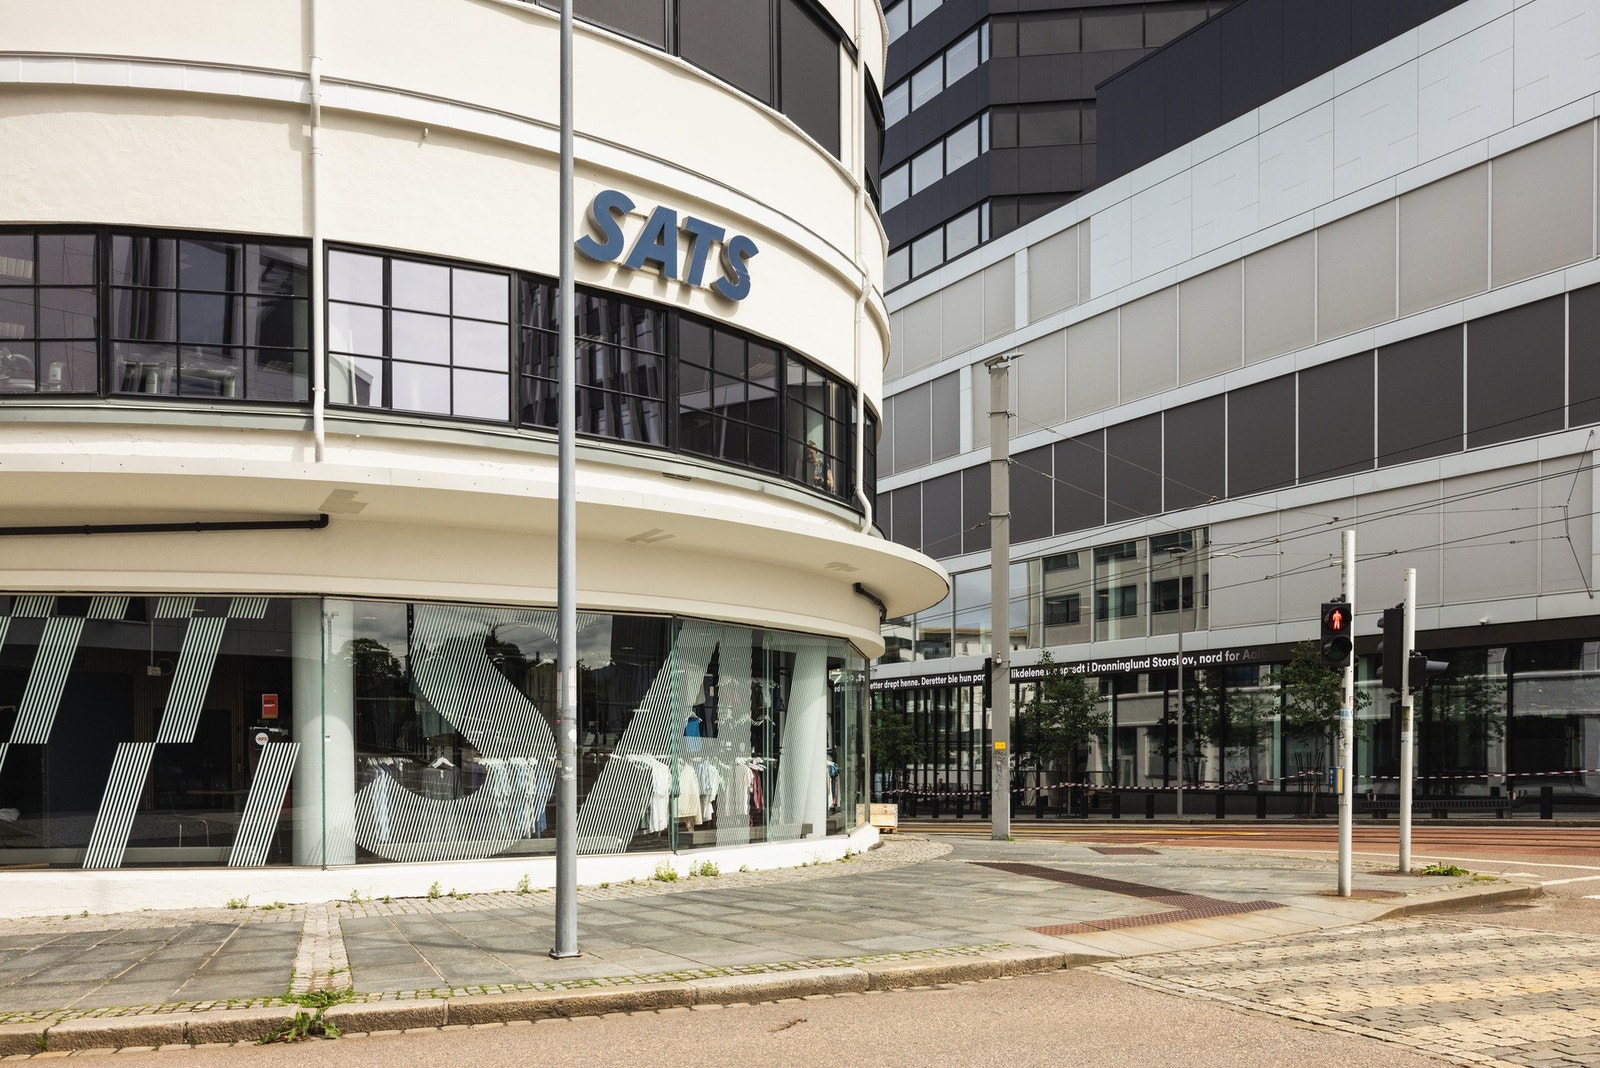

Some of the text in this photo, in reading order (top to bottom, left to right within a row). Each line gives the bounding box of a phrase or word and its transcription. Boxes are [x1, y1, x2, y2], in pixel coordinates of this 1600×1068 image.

[575, 189, 760, 301] SATS
[884, 679, 900, 691] drept
[900, 677, 920, 688] henne.
[921, 675, 947, 686] Deretter
[948, 674, 958, 684] ble
[960, 673, 972, 682] hun
[1011, 667, 1044, 679] likdelene
[1060, 663, 1085, 677] spedt
[1087, 662, 1090, 673] i
[1092, 658, 1150, 672] Dronninglund
[1200, 650, 1222, 664] nord
[1225, 650, 1240, 662] for
